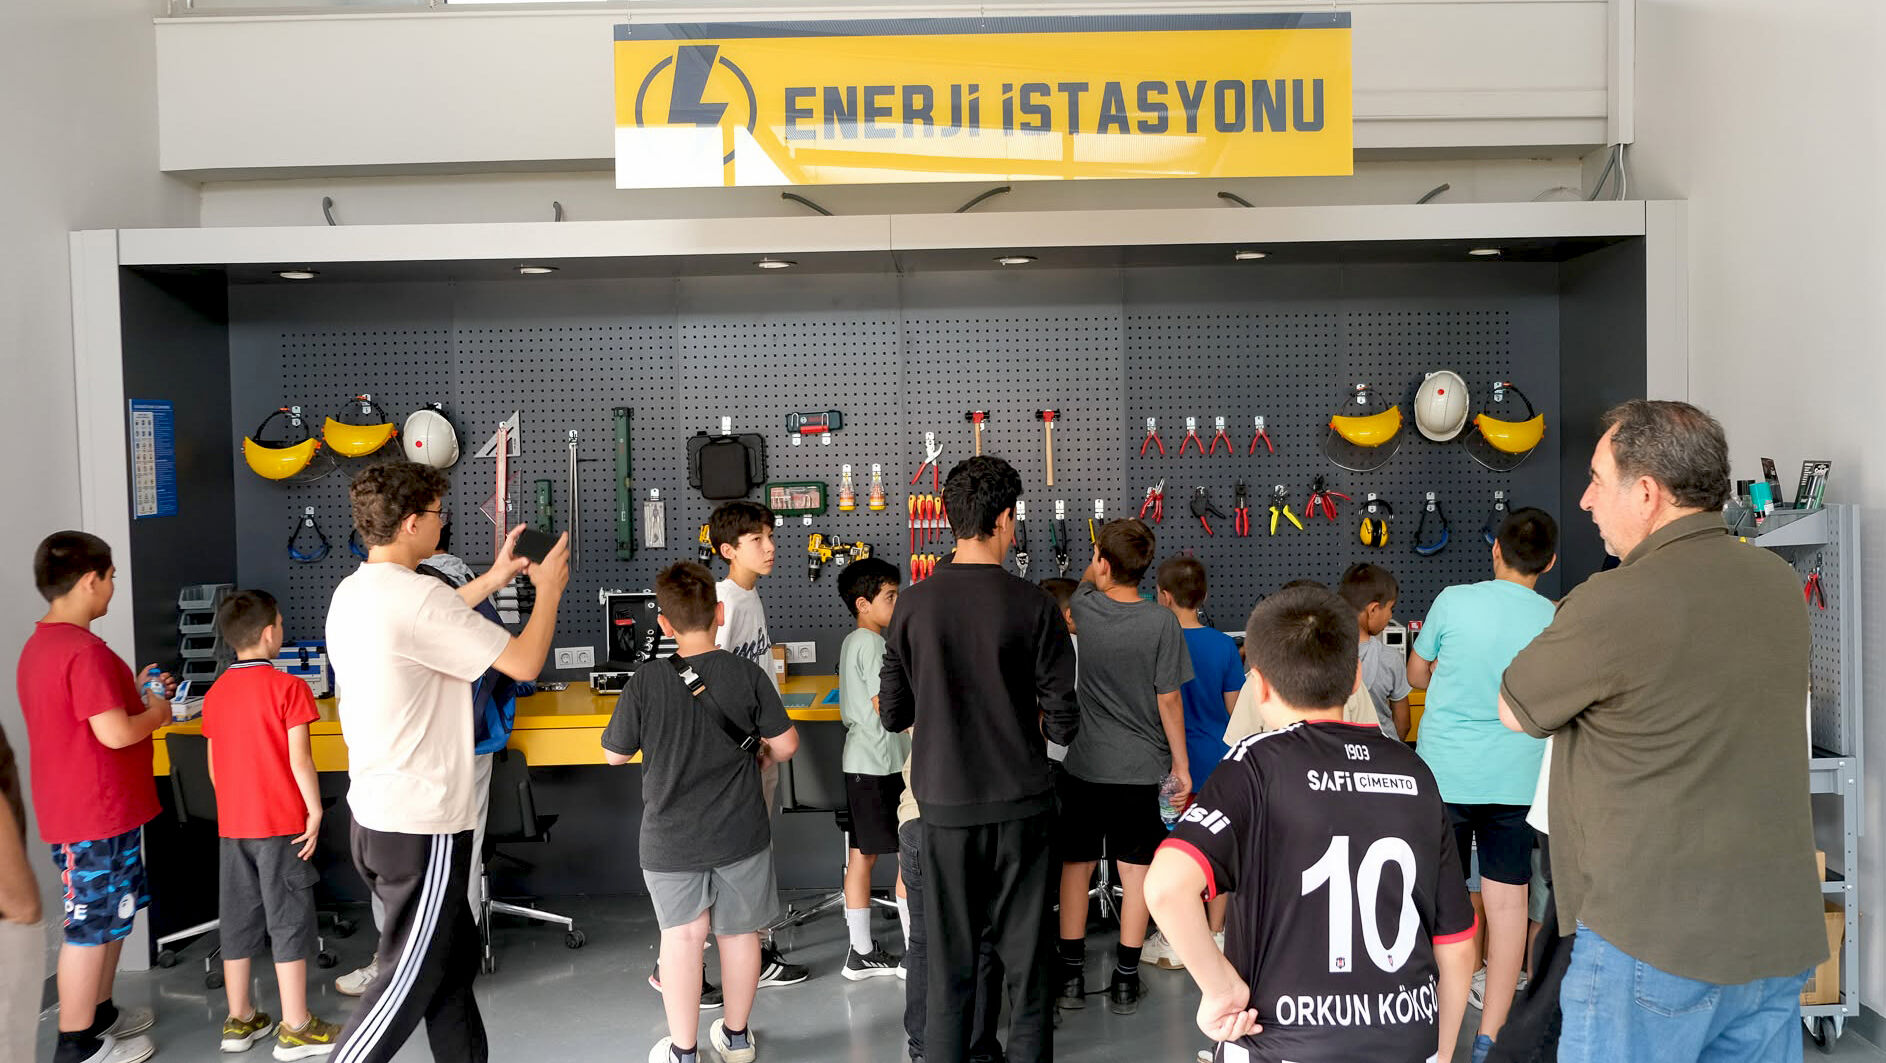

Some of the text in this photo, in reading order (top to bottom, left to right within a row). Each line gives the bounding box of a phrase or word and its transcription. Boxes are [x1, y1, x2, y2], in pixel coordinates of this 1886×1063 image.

[1344, 743, 1370, 761] 1903
[1359, 774, 1413, 790] ÇİMENTO
[1301, 835, 1421, 973] 10
[1275, 974, 1438, 1026] ORKUN KÖKÇÜ
